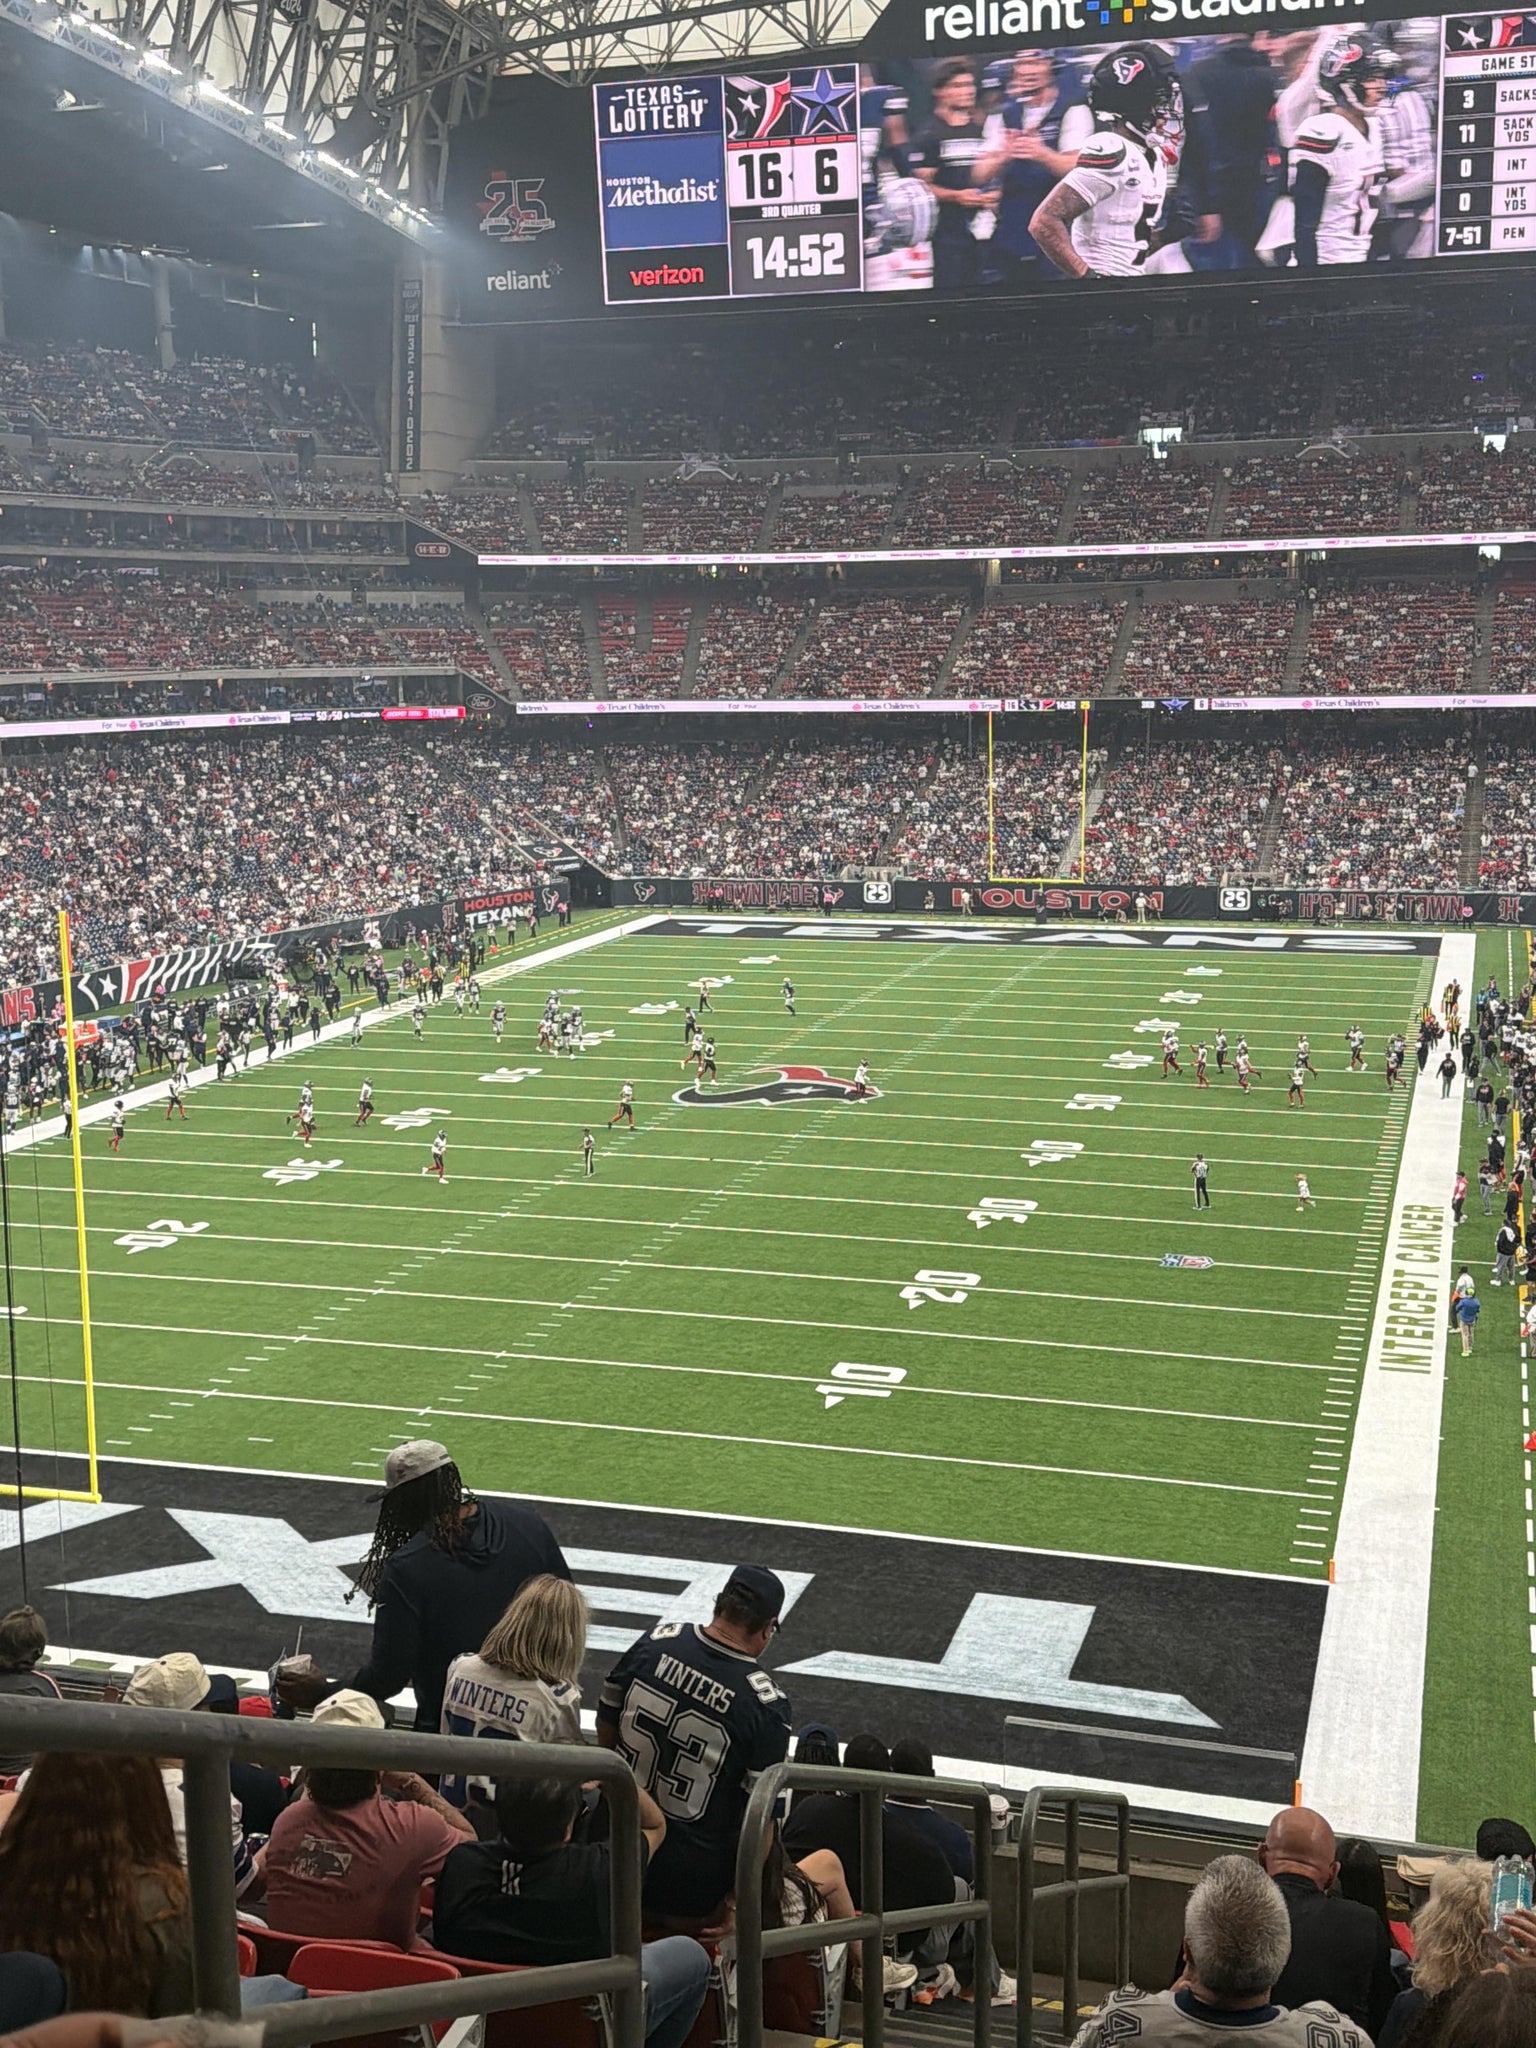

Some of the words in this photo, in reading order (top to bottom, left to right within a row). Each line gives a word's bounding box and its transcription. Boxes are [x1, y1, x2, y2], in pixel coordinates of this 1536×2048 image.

[924, 0, 1085, 41] reliant
[1481, 57, 1516, 71] GAME
[626, 85, 683, 107] TEXAS
[1462, 89, 1475, 109] 3
[609, 98, 705, 133] LOTTERY
[1458, 123, 1476, 144] 11
[1503, 116, 1534, 131] SACK
[1507, 130, 1530, 143] YDS
[606, 176, 651, 187] HOUSTON
[738, 152, 783, 200] 16
[815, 148, 839, 196] 6
[1460, 158, 1472, 178] 0
[1507, 158, 1528, 171] INT
[607, 178, 718, 208] Methodist
[1458, 192, 1471, 212] 0
[1506, 186, 1526, 199] INT
[1504, 199, 1527, 212] YDS
[761, 206, 780, 218] 3RD
[781, 203, 822, 219] QUARTER
[1445, 225, 1482, 247] 7-51
[1502, 226, 1526, 240] PEN
[746, 232, 846, 280] 14:52
[487, 270, 551, 291] reliant
[629, 264, 705, 287] verizon
[464, 890, 536, 911] HOUSTON
[766, 882, 815, 906] MADE
[866, 883, 889, 902] 25
[466, 903, 534, 927] TEXAN
[677, 923, 1418, 950] TEXANS
[0, 987, 36, 1027] NS
[967, 1197, 1038, 1224] 30
[113, 1218, 210, 1251] 20
[1395, 1204, 1445, 1264] CANCER
[899, 1269, 982, 1304] 20
[1379, 1269, 1440, 1375] INTERCEPT
[815, 1361, 907, 1400] 10
[654, 1653, 736, 1714] WINTERS
[450, 1677, 530, 1724] WINTERS
[616, 1678, 732, 1823] 53
